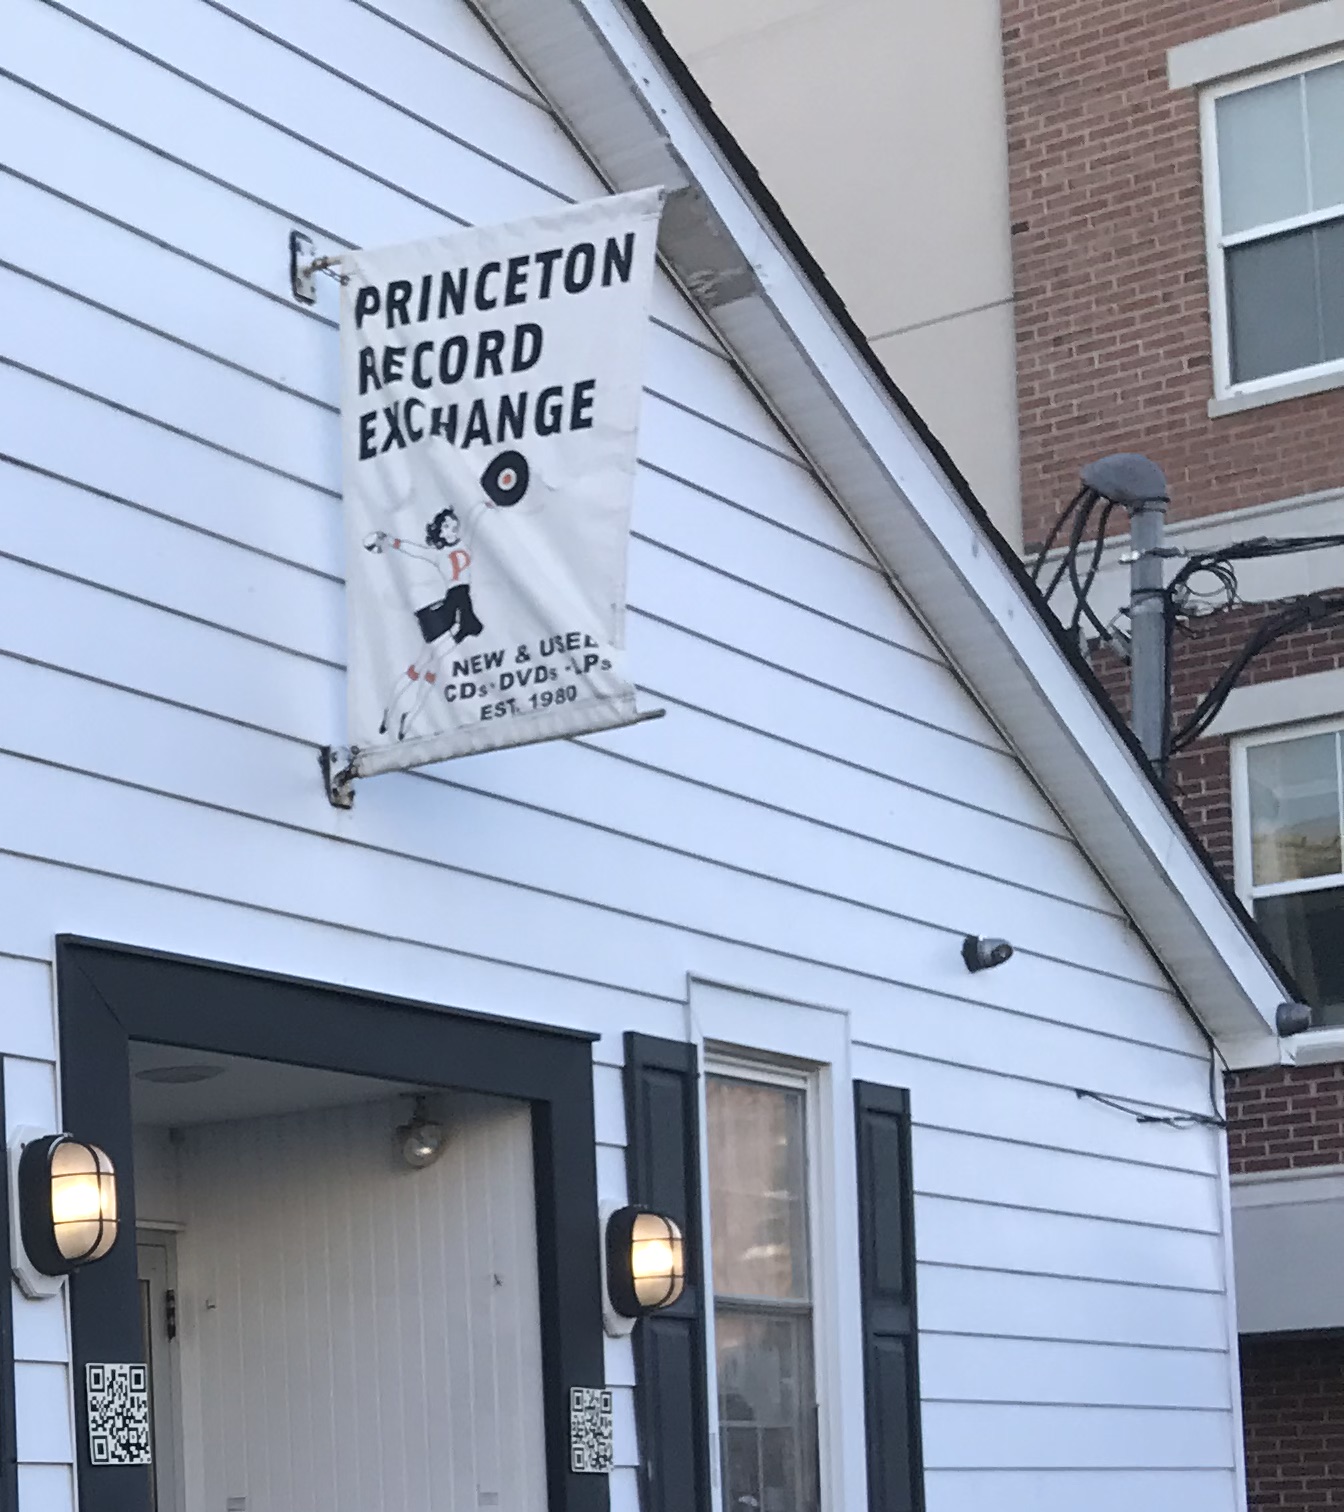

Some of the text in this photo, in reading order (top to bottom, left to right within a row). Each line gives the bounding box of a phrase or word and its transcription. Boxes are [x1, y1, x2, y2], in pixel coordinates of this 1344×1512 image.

[355, 232, 635, 330] PRINCETON
[358, 323, 543, 395] RECORD
[358, 379, 596, 461] EXCHANGE
[444, 682, 488, 703] CDs
[500, 665, 558, 690] DVDs
[453, 650, 506, 677] NEW
[515, 644, 531, 664] &
[529, 685, 577, 709] 1980
